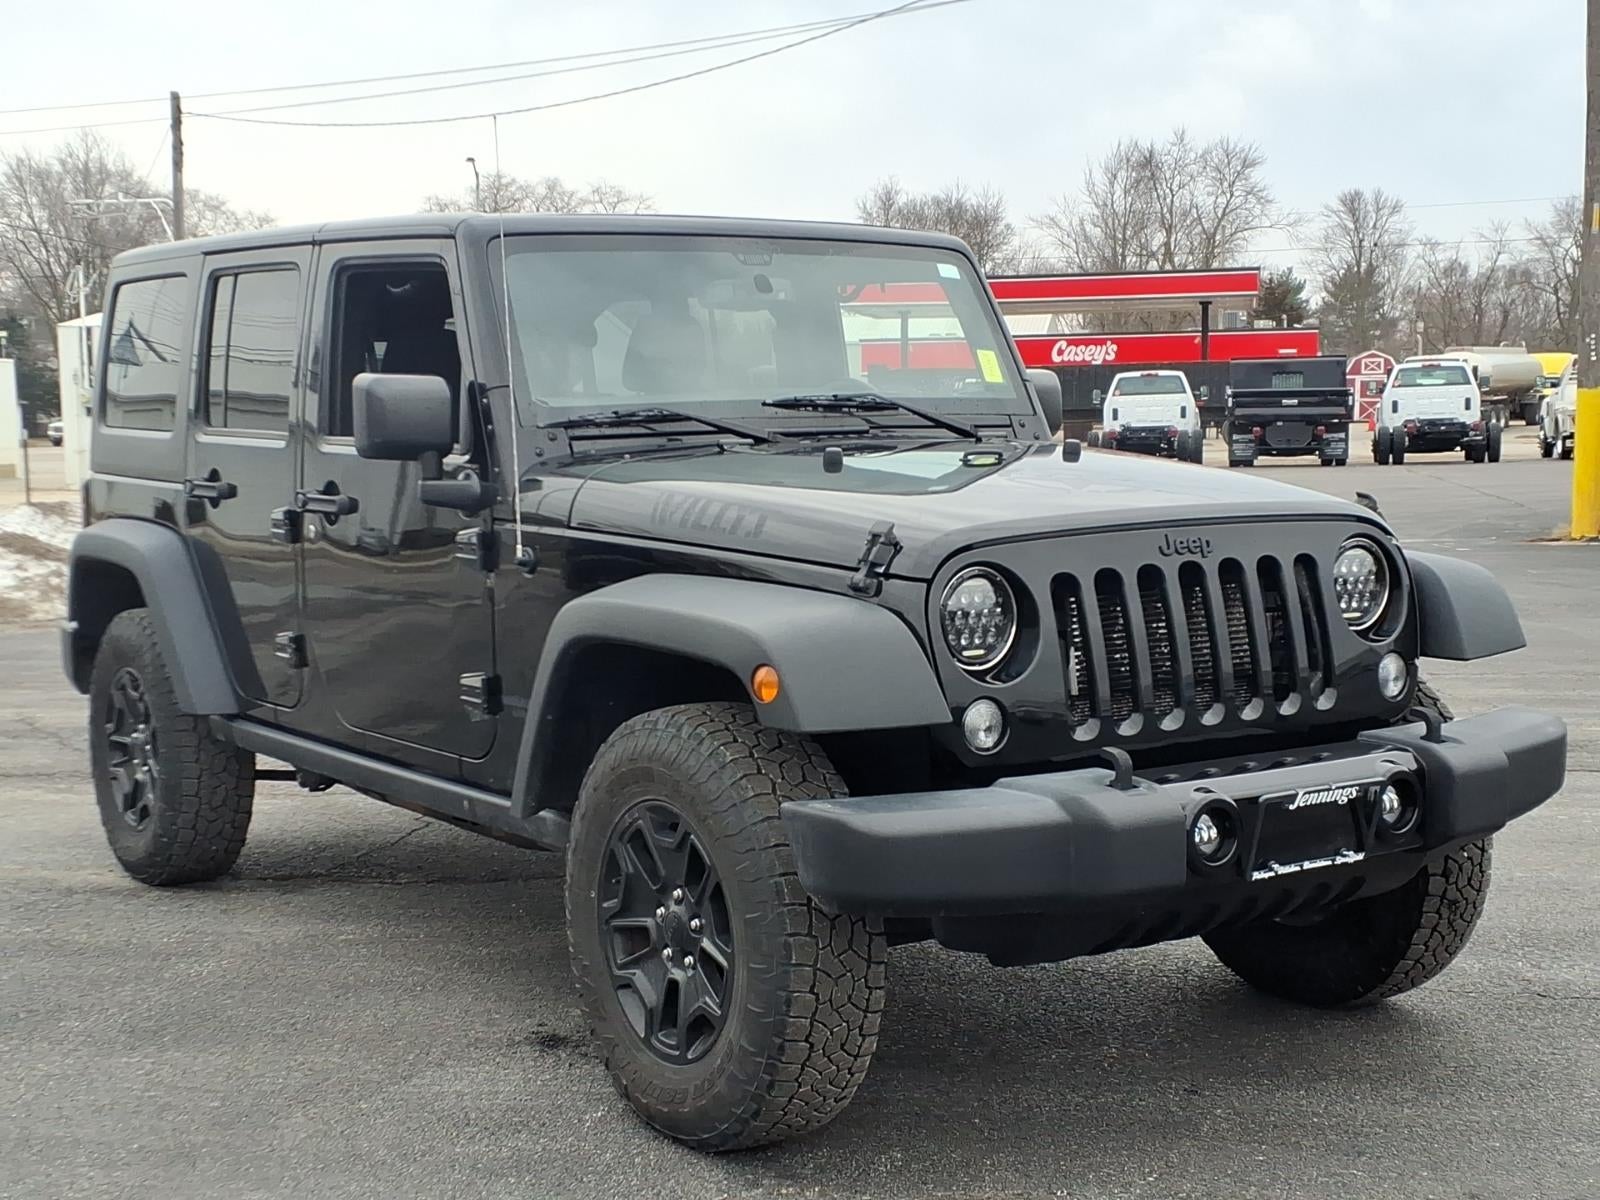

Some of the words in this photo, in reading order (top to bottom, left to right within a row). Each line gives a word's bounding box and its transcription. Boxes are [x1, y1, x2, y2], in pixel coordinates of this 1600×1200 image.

[1051, 339, 1118, 365] Casey's
[1158, 533, 1214, 559] Jeep
[1288, 785, 1360, 810] Jennings
